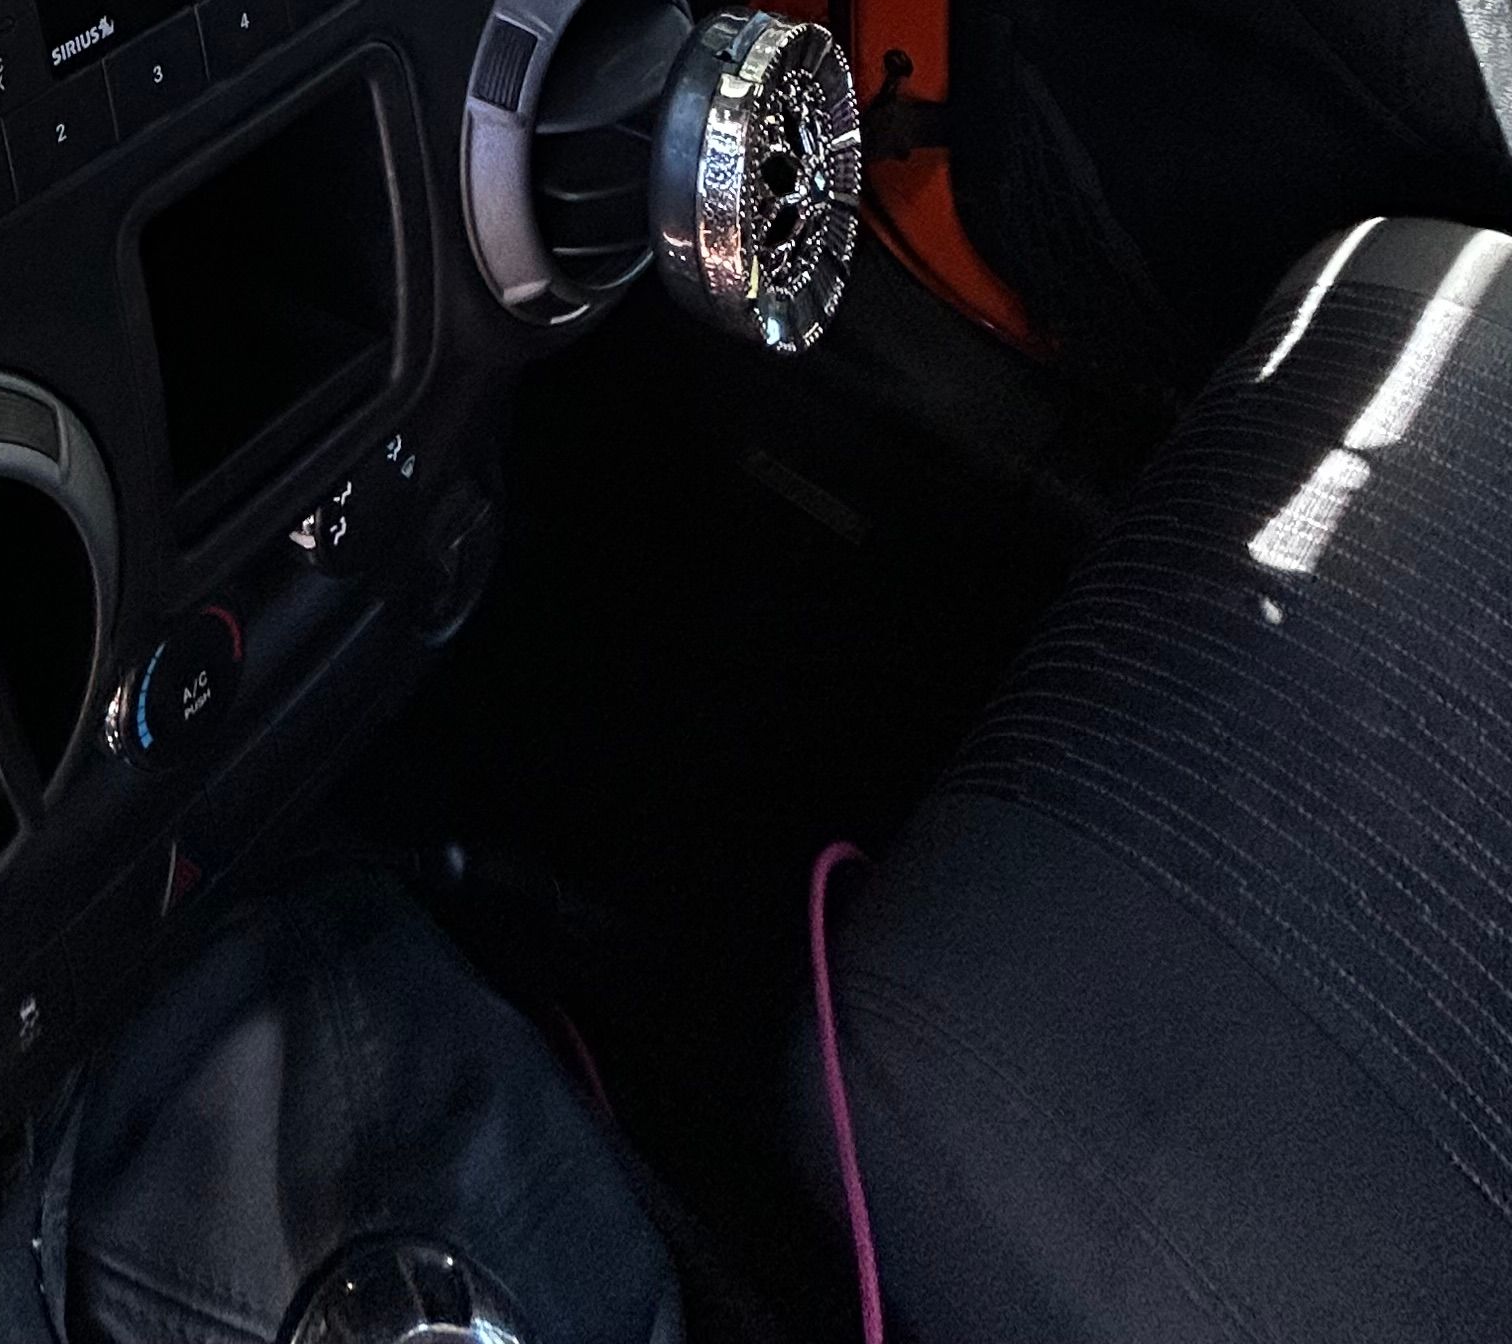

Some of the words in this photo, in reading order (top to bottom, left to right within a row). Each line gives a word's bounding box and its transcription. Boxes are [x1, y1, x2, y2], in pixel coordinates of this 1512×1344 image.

[240, 12, 250, 29] 4
[51, 25, 100, 66] SIRIUS
[153, 65, 164, 83] 3
[55, 123, 67, 143] 2
[183, 670, 208, 704] A/C
